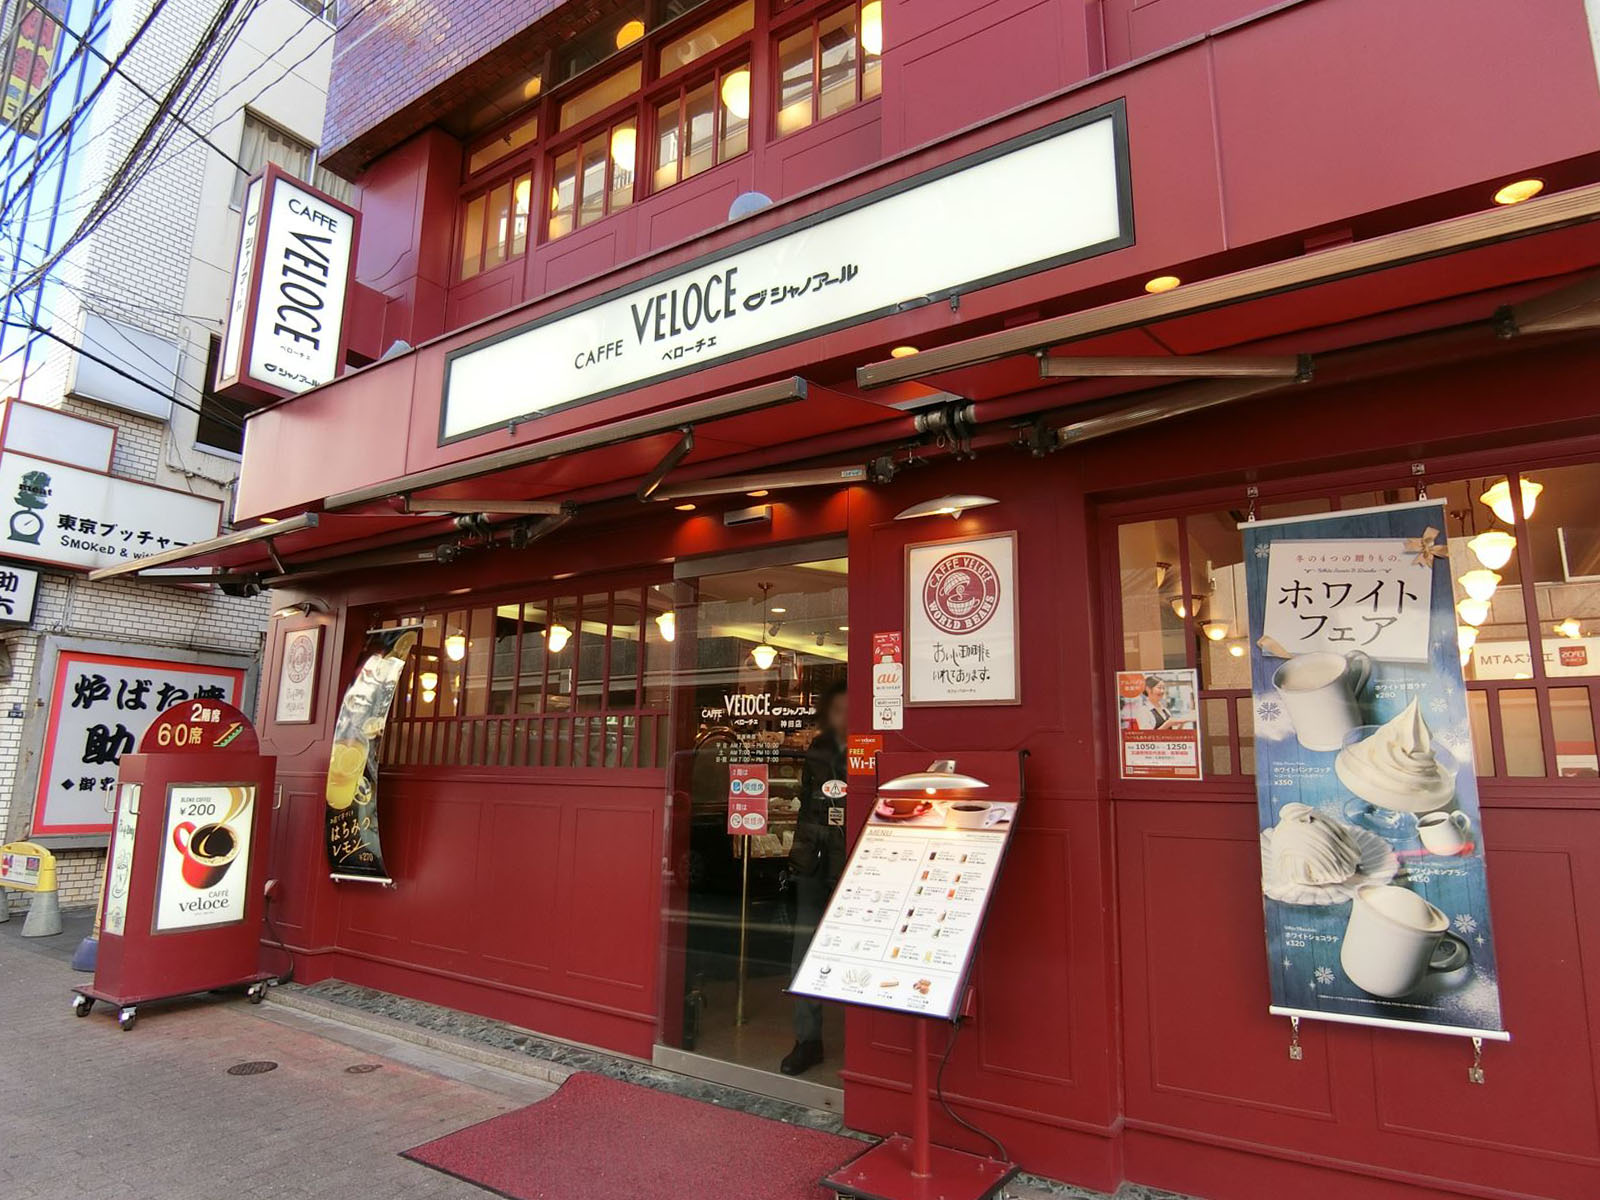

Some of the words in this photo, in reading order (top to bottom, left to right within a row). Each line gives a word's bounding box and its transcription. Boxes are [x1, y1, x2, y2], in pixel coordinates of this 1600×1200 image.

[288, 199, 338, 233] CAFFE
[273, 231, 333, 351] VELOCE
[770, 264, 859, 305] シャノアール
[574, 339, 624, 370] CAFFE
[631, 267, 738, 345] VELOCE
[661, 336, 717, 361] ベローチェ
[57, 513, 199, 546] 東京ブッチャー
[119, 547, 128, 557] &
[929, 558, 960, 588] CAFFE
[963, 557, 993, 582] VELOCE
[1277, 579, 1419, 615] ホワイト
[928, 601, 962, 630] WORLD
[964, 595, 995, 628] BEANS
[1299, 614, 1399, 646] フェア
[877, 673, 899, 684] au
[190, 703, 222, 723] 2階席
[724, 692, 771, 716] VELOCE
[157, 722, 204, 747] 60席
[849, 756, 877, 769] Wi-F
[180, 803, 216, 816] ¥200
[331, 816, 371, 842] はちみつ
[332, 838, 362, 857] レモン
[179, 897, 230, 912] veloce
